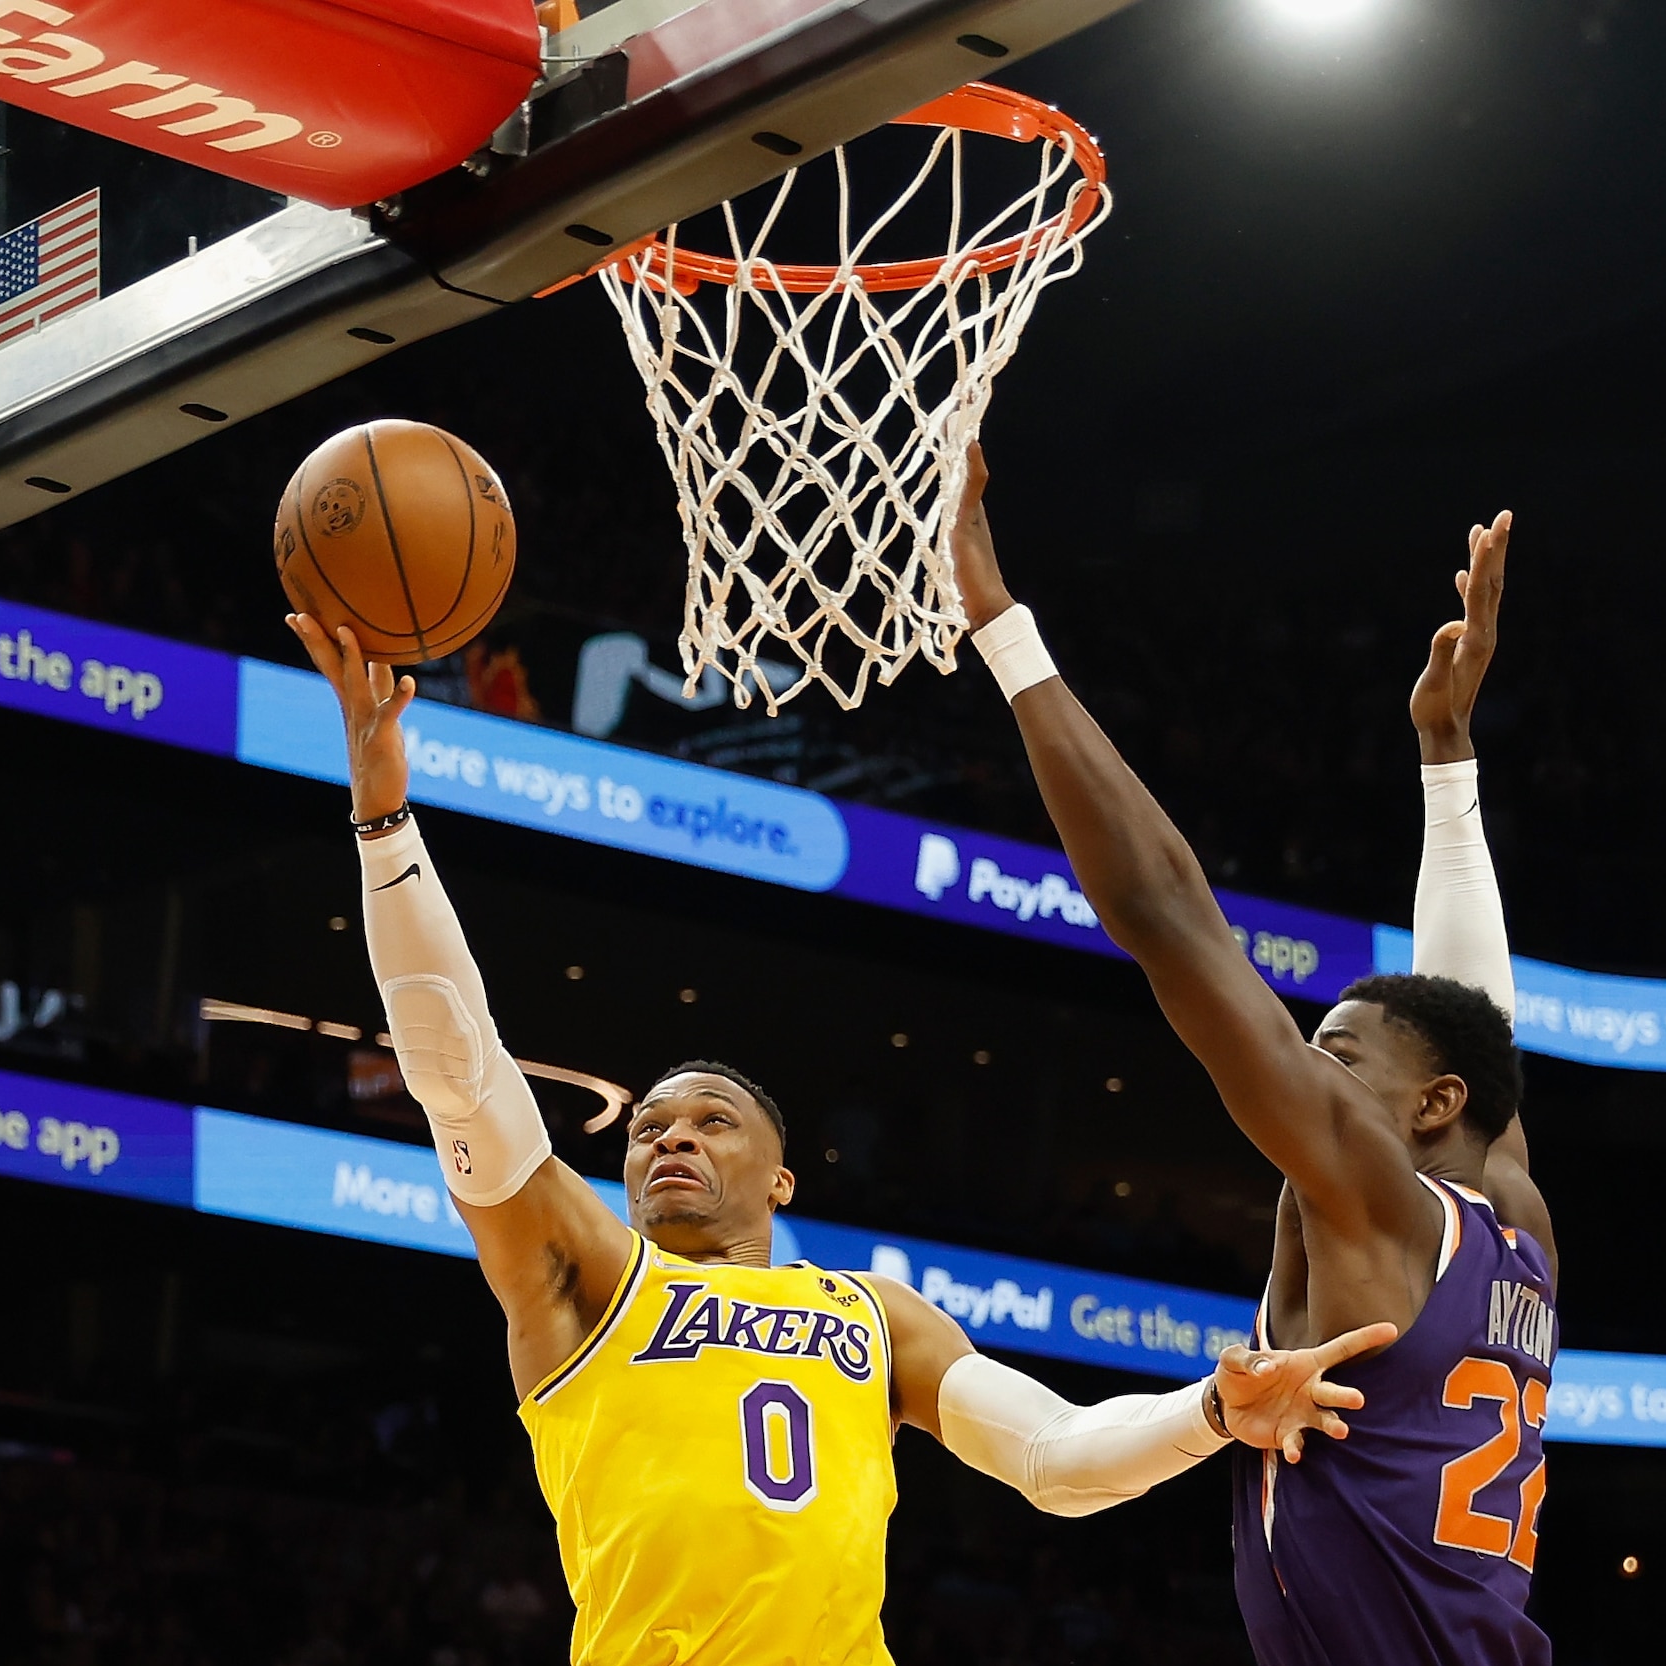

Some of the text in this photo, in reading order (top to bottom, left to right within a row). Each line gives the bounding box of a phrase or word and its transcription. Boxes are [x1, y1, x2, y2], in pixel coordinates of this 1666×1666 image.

[79, 658, 164, 720] app
[405, 722, 800, 858] ore ways to explore.
[968, 857, 1101, 929] PayPa
[1252, 931, 1319, 983] app
[1565, 1004, 1661, 1053] ways
[35, 1115, 121, 1176] app
[332, 1159, 441, 1223] More
[627, 1280, 876, 1385] LAKERS
[921, 1264, 1054, 1333] PayPal
[1069, 1292, 1135, 1349] Get
[1138, 1303, 1200, 1361] the
[1203, 1322, 1256, 1362] ap
[1487, 1280, 1555, 1368] AYTON
[1546, 1380, 1625, 1428] ays
[737, 1378, 819, 1513] 0
